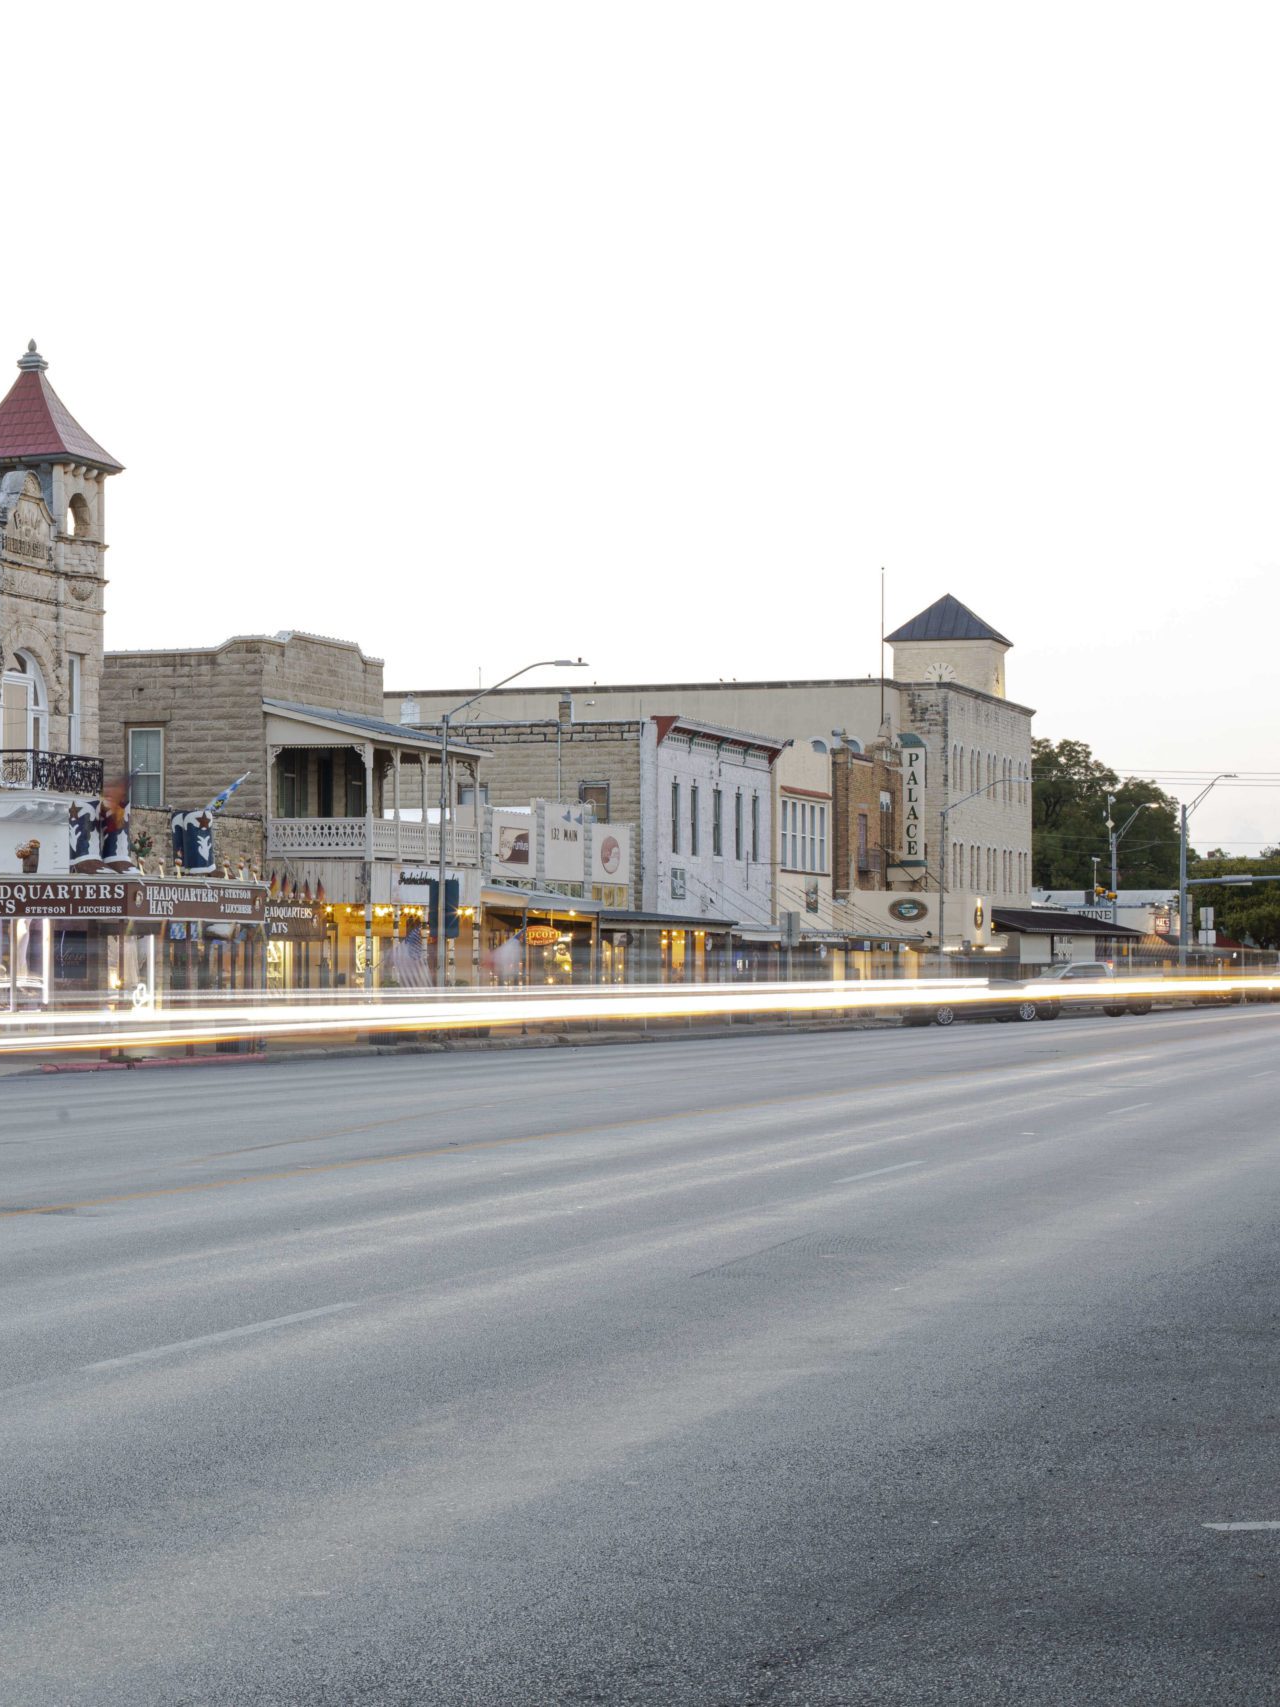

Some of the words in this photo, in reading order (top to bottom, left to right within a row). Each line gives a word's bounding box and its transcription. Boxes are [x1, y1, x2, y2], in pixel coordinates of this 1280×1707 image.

[906, 752, 920, 855] PALACE
[551, 828, 560, 840] 132
[563, 828, 578, 841] MAIN
[146, 886, 219, 904] HEADQUARTERS
[25, 906, 66, 914] STETSON
[78, 906, 122, 914] LUCCHESE
[149, 900, 174, 915] HATS
[264, 906, 313, 919] EADQUARTERS
[1077, 910, 1112, 920] WINE
[269, 920, 289, 934] ATS
